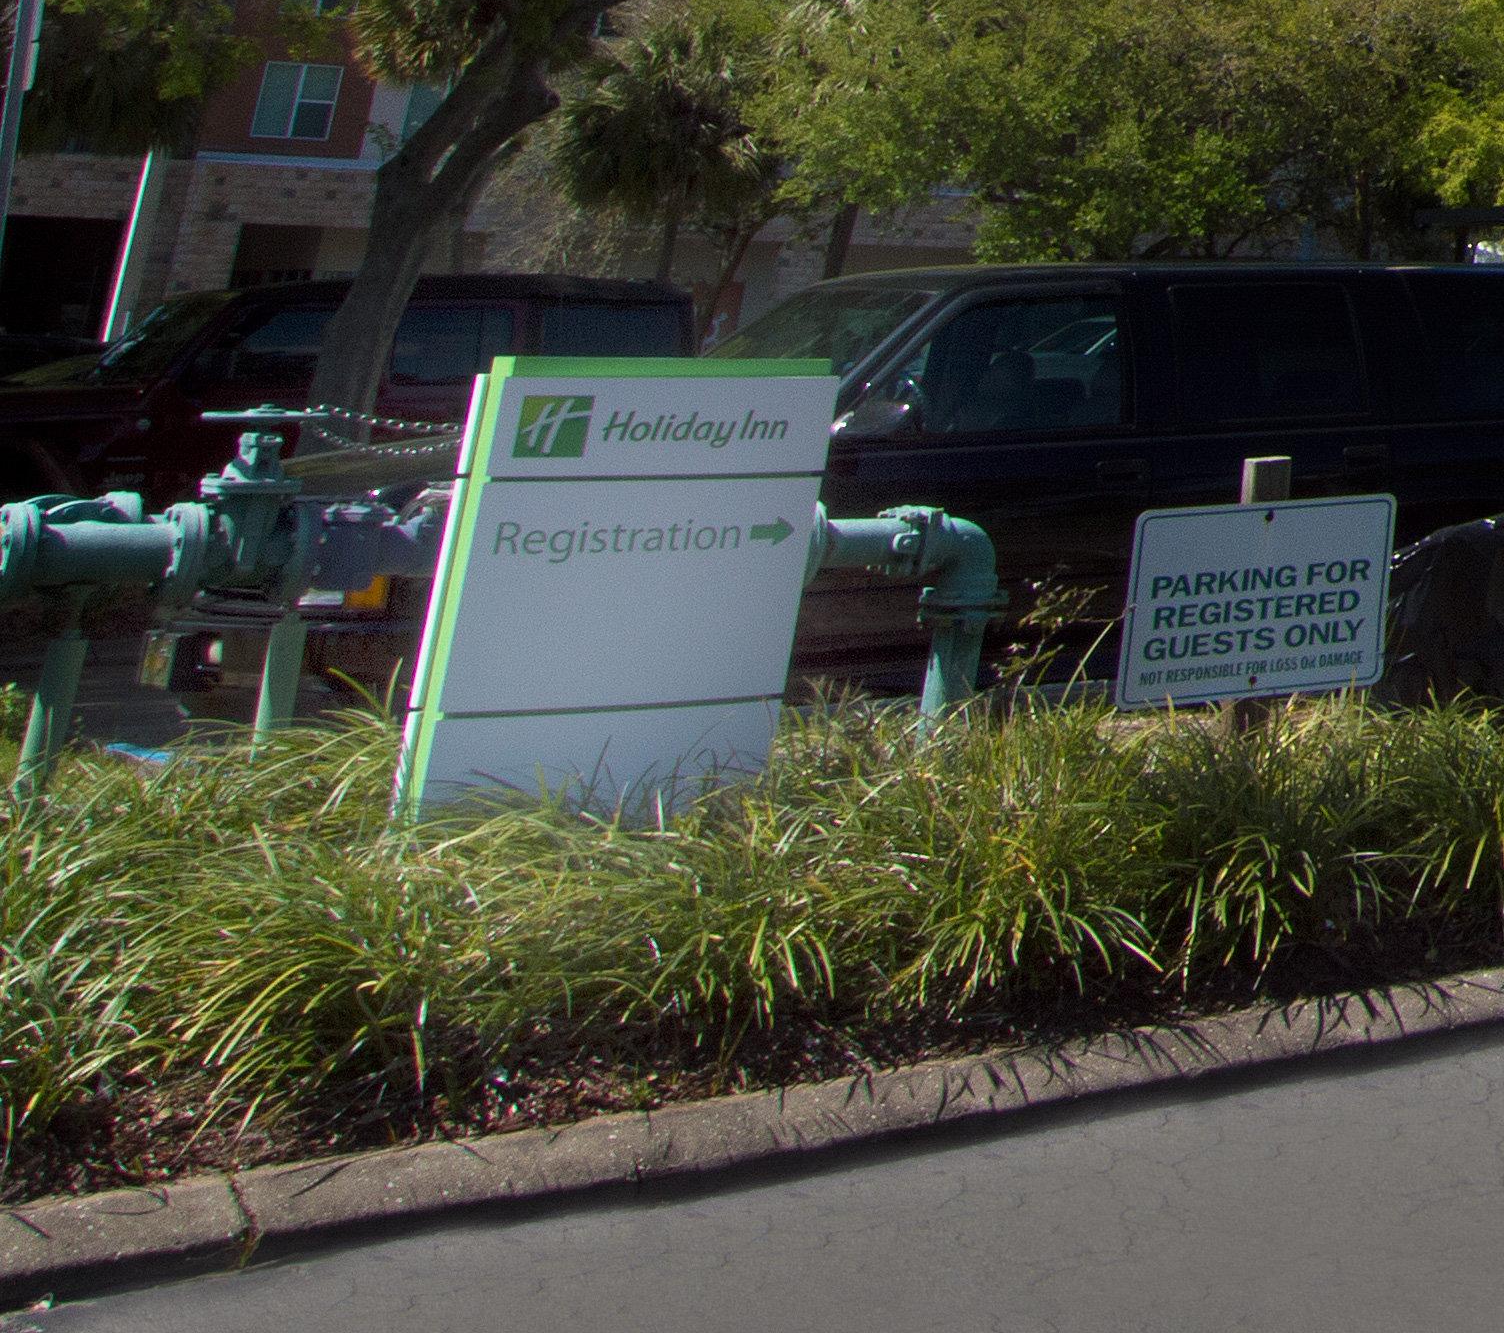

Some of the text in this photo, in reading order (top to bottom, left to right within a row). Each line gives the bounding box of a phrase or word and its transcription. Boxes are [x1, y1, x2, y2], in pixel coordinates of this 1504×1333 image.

[602, 409, 790, 449] Holiday Inn
[491, 520, 741, 564] Registration
[1151, 559, 1371, 600] PARKING FOR
[1153, 589, 1361, 631] REGISTERED
[1142, 618, 1366, 662] GUESTS ONLY
[1139, 671, 1164, 686] NOT
[1165, 662, 1243, 683] RESPONSIBLE
[1245, 660, 1268, 675] FOR
[1270, 658, 1298, 673] LOSS
[1318, 650, 1365, 668] DAMAGE
